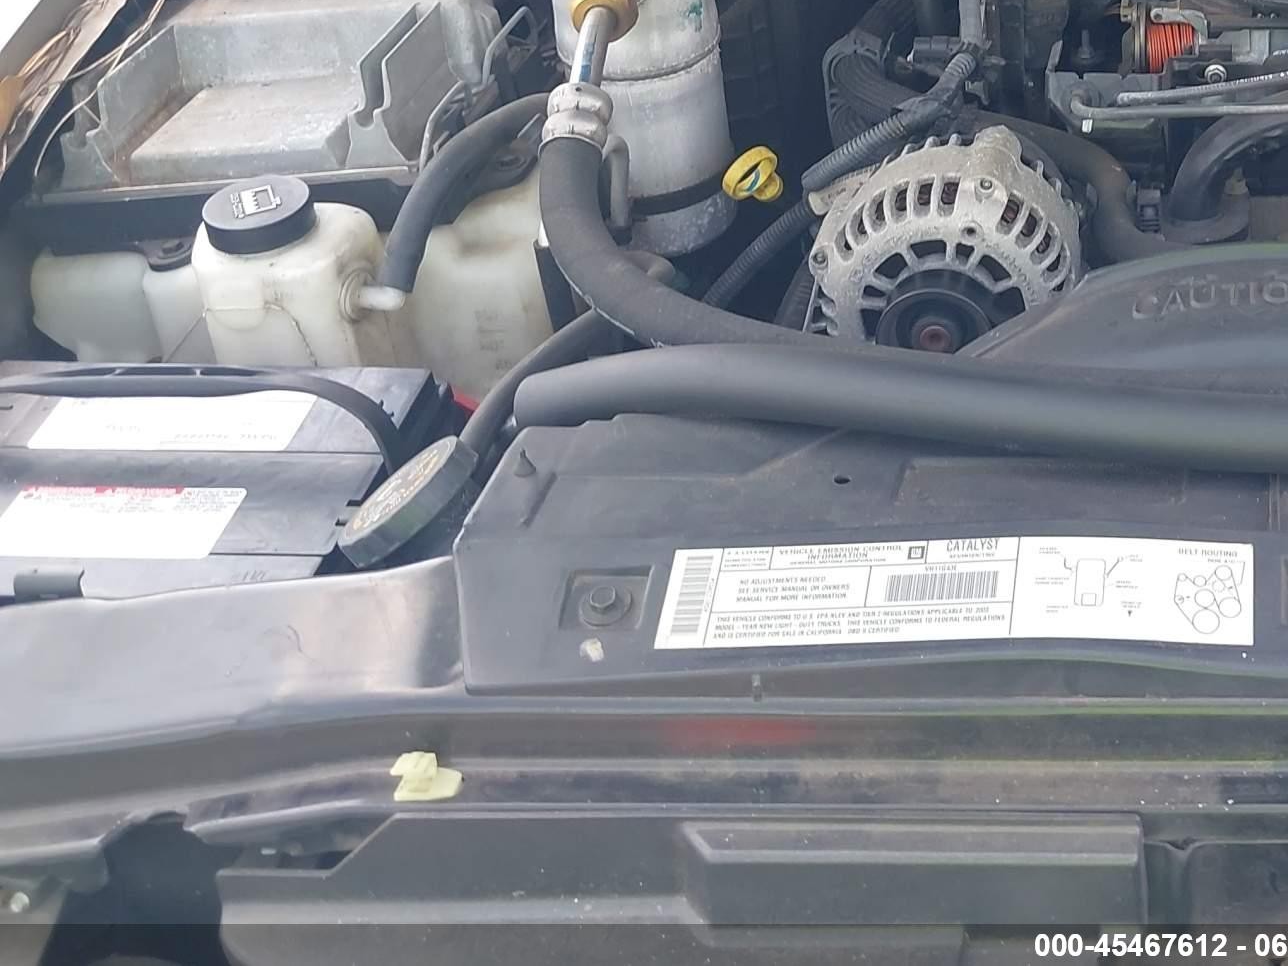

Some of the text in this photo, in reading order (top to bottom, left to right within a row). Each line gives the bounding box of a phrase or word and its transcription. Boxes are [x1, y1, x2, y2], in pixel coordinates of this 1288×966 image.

[1201, 549, 1238, 557] ROUTING
[750, 576, 798, 584] ADJUSTMENTS
[801, 592, 846, 600] INFORMATION
[883, 608, 924, 616] REGULATIONS
